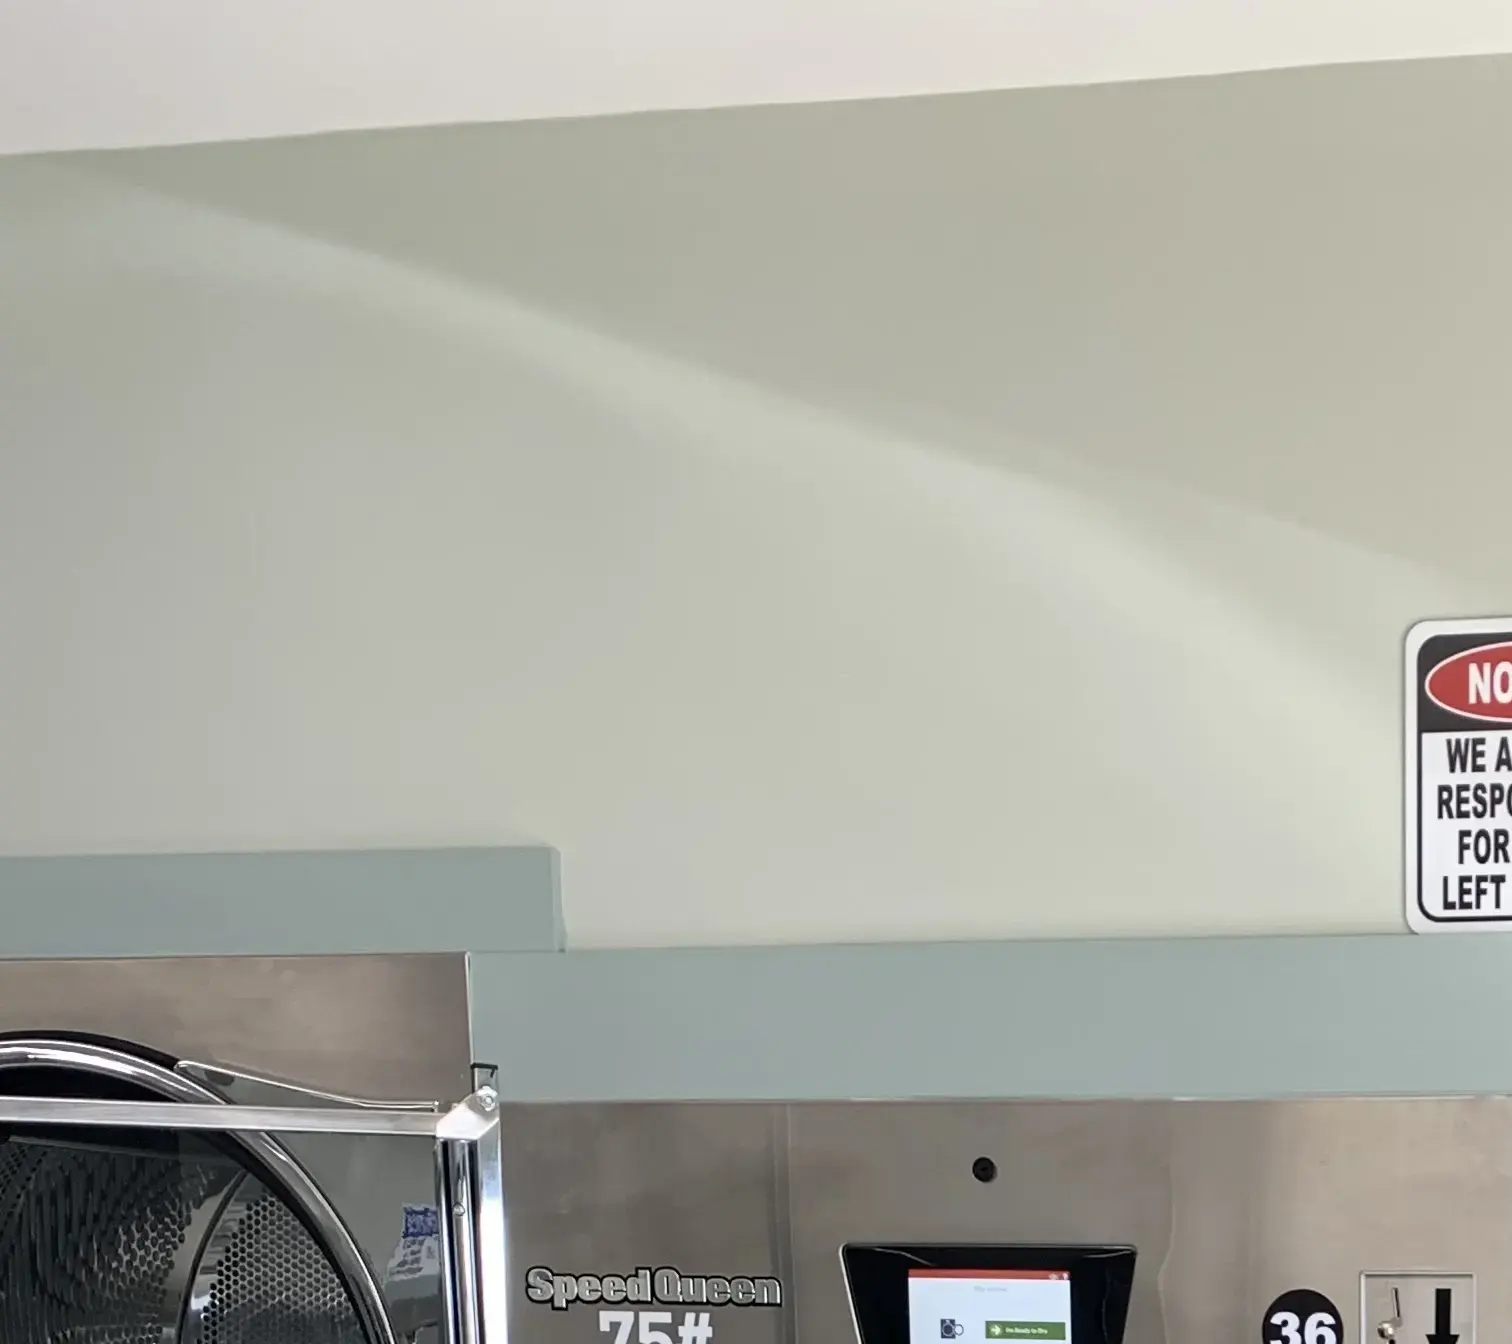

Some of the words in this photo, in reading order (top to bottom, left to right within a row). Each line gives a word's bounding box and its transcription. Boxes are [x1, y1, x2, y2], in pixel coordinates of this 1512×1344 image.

[1446, 737, 1486, 773] WE
[1458, 828, 1511, 865] FOR
[1442, 874, 1506, 910] LEFT
[525, 1266, 653, 1310] Speed
[653, 1266, 782, 1307] Queen
